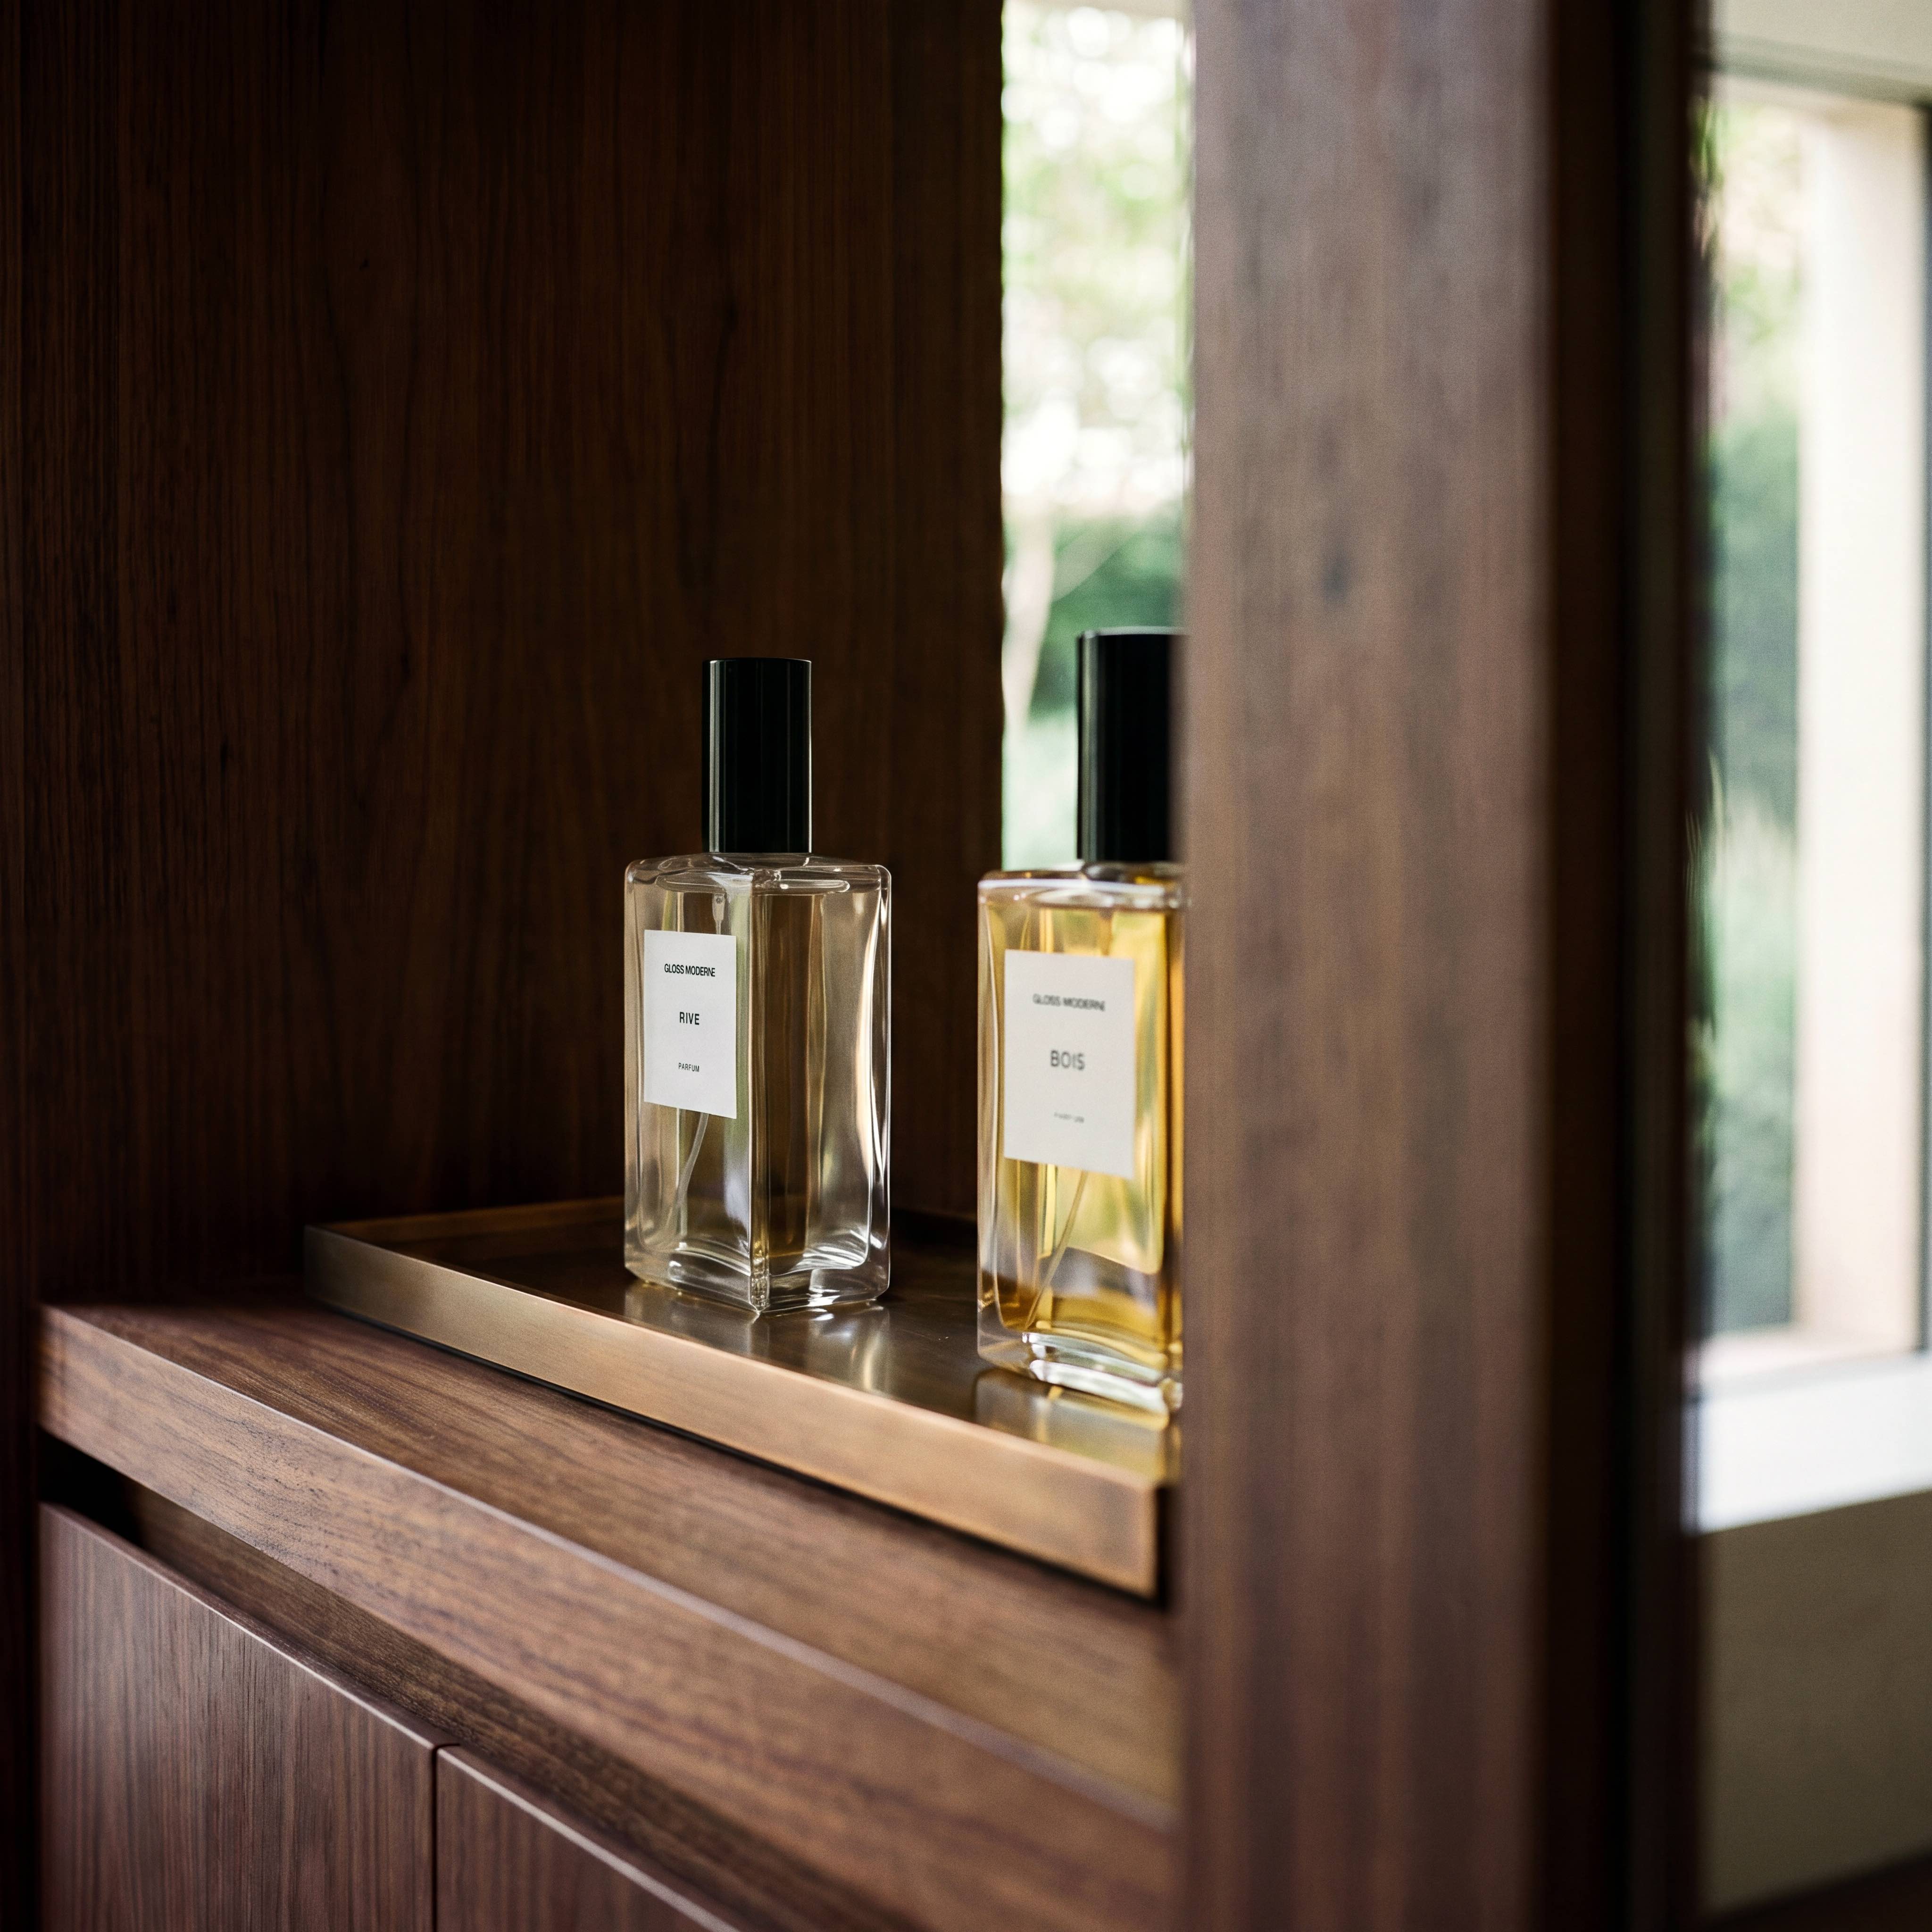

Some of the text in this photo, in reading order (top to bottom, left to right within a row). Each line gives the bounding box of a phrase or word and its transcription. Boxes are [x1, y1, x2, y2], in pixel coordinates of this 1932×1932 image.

[665, 964, 715, 977] GLOSS MODERNE
[680, 1012, 700, 1025] RIVE
[1050, 1049, 1085, 1071] BOIS
[679, 1063, 700, 1073] PARFUM
